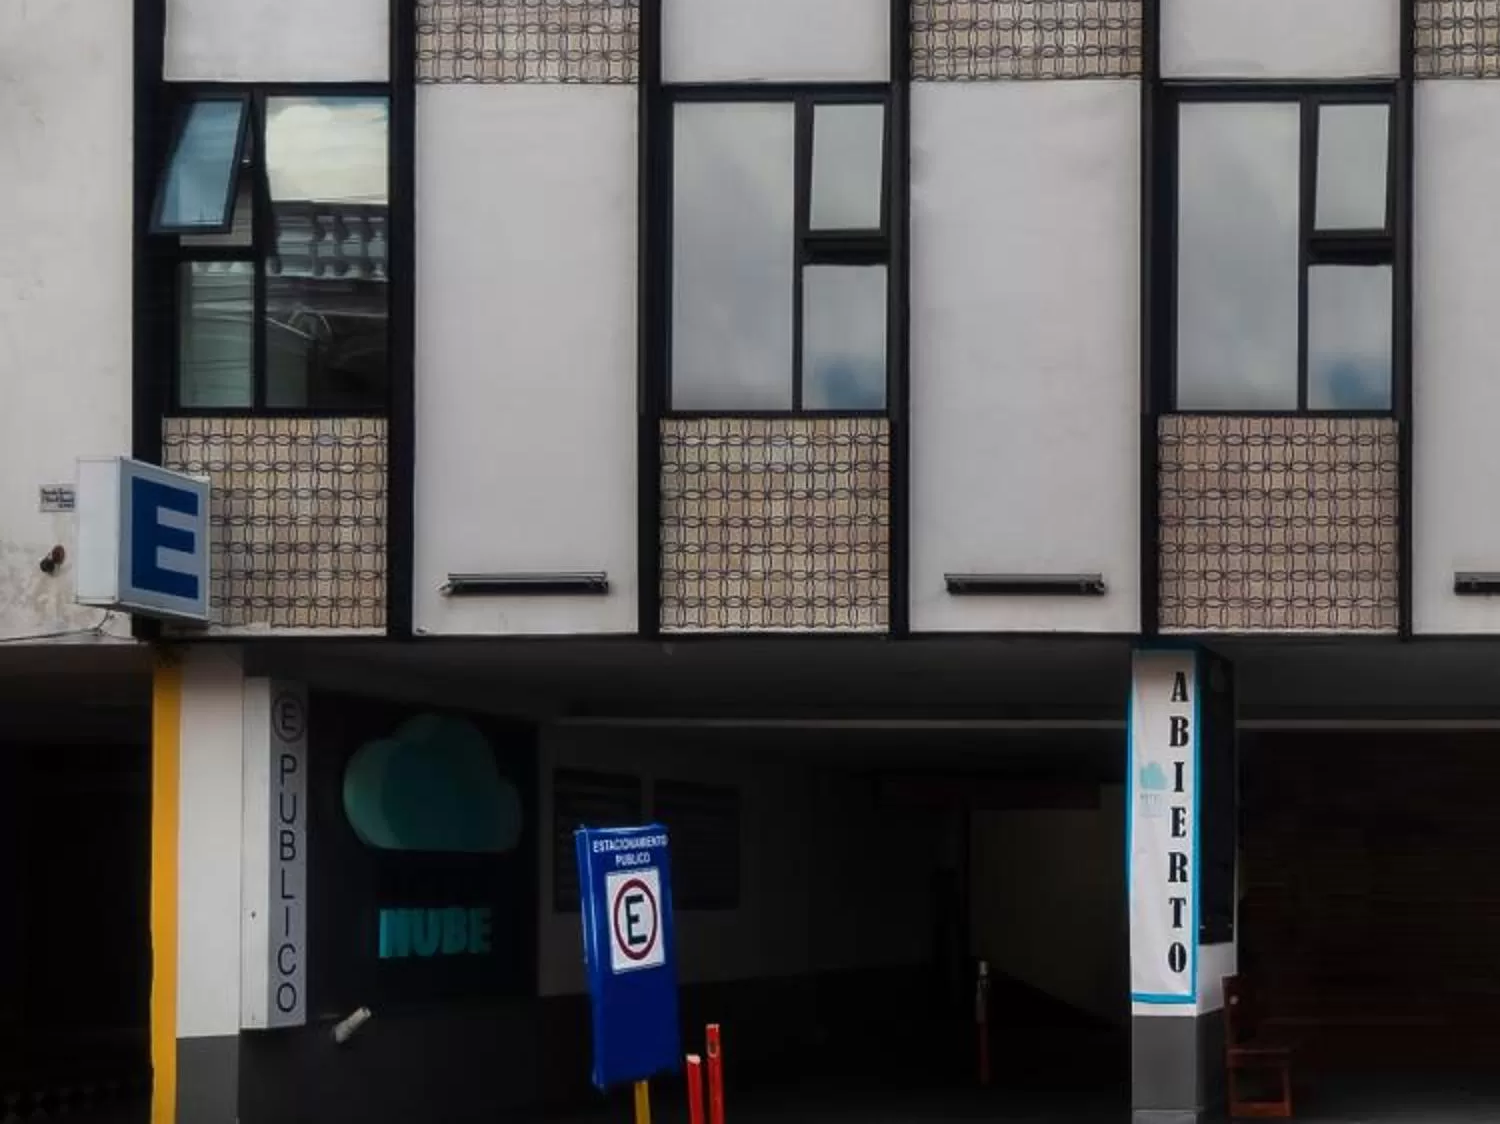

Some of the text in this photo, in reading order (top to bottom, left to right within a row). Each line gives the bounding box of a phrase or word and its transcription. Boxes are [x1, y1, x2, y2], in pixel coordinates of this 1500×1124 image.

[132, 476, 199, 600] E
[277, 754, 297, 1013] PUBLICO
[1168, 672, 1189, 973] ABIERTO
[378, 907, 492, 956] NUBE
[624, 894, 647, 946] E
